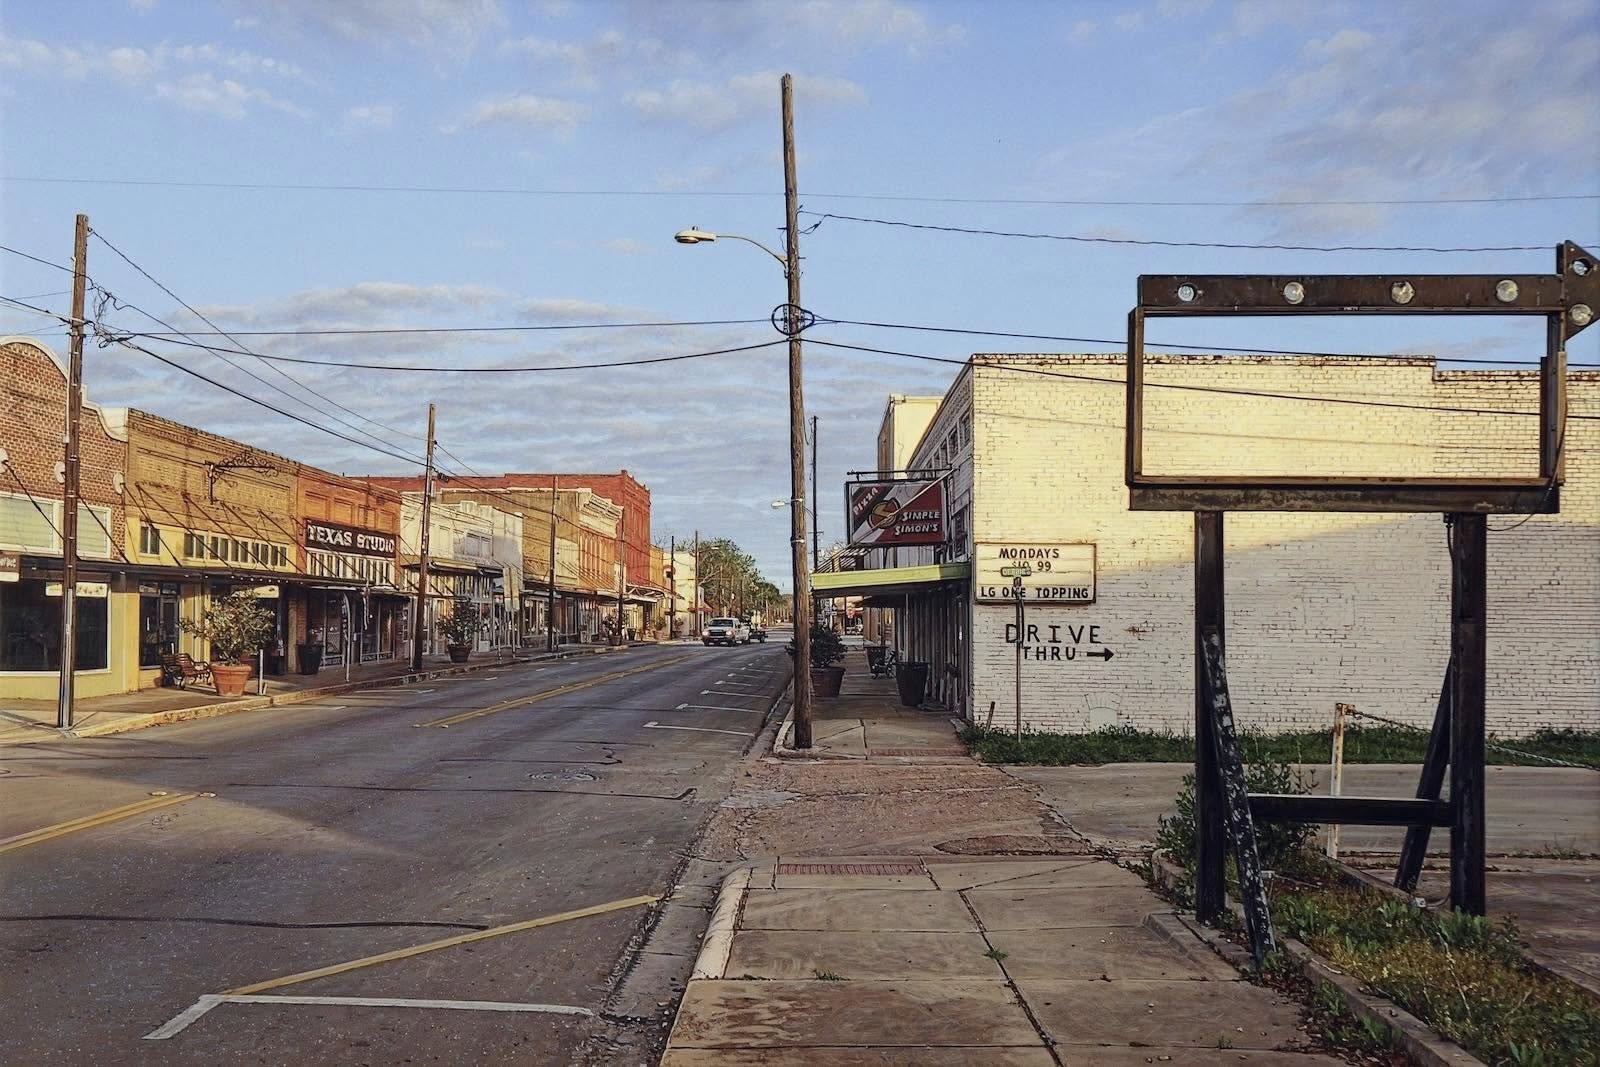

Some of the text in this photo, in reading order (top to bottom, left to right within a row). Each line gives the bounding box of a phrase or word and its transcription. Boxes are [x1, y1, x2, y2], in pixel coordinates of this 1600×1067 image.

[853, 487, 879, 515] PIZZA
[902, 511, 940, 522] SIMPLE
[894, 523, 938, 536] SIMON'S
[307, 524, 395, 553] TEXAS STUDIO
[1037, 561, 1052, 572] 99
[981, 586, 996, 597] LG
[1035, 587, 1089, 598] TOPPING
[1005, 623, 1102, 644] DRIVE
[1022, 646, 1076, 660] THRU
